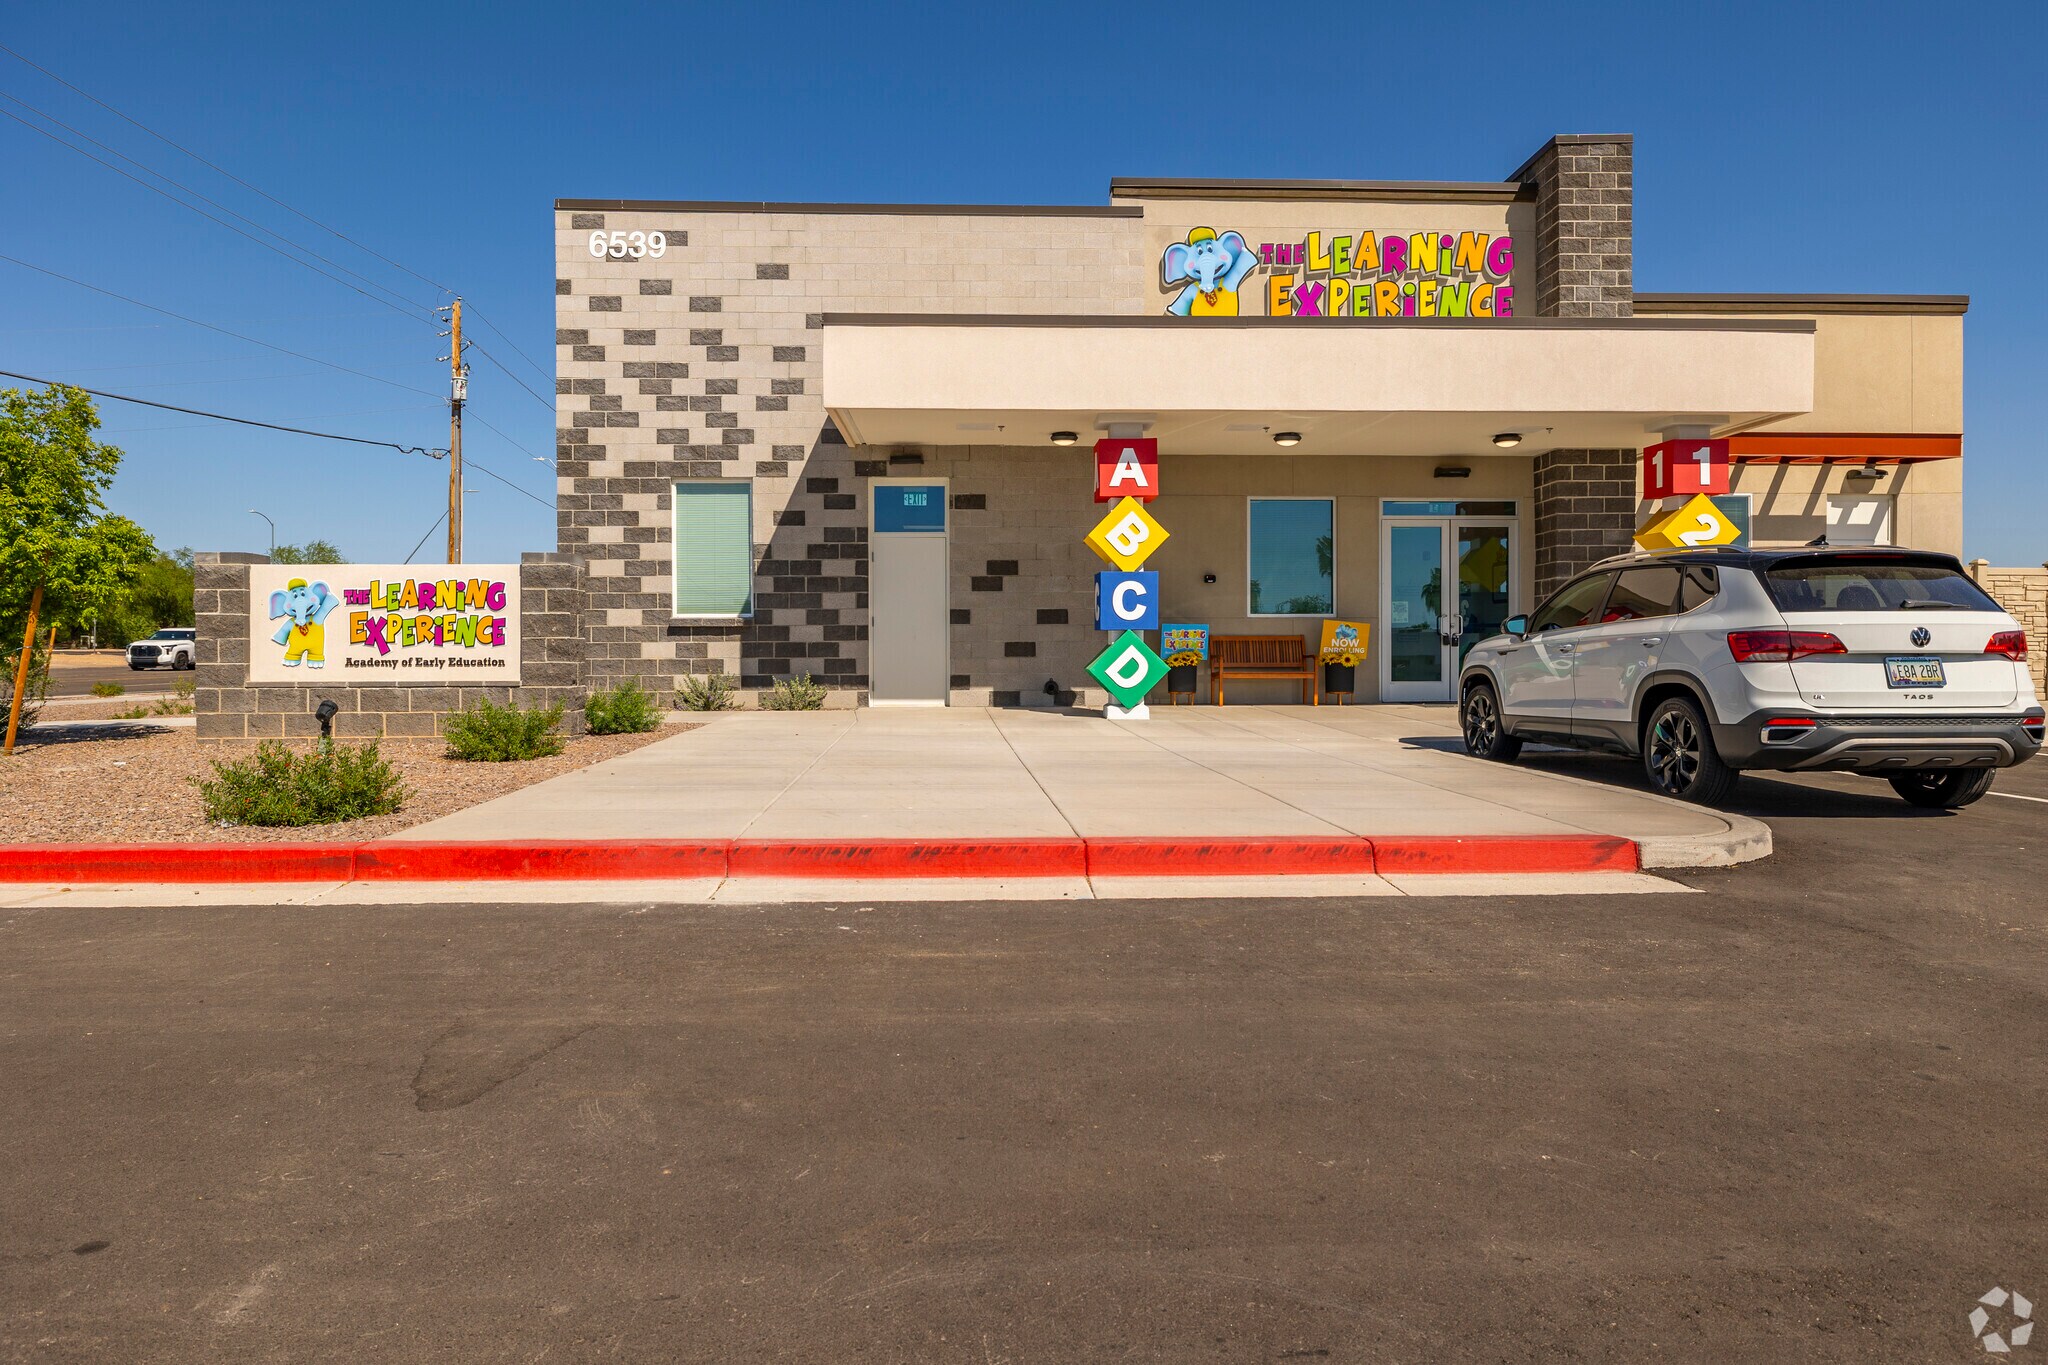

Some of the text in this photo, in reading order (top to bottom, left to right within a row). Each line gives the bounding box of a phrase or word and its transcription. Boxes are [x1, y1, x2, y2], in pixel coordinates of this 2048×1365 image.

[588, 230, 667, 259] 6539
[1260, 243, 1304, 265] THE
[1108, 447, 1149, 488] A
[1692, 446, 1711, 486] 1
[1104, 511, 1150, 556] B
[1678, 513, 1721, 547] 2
[343, 589, 371, 605] THE
[1112, 580, 1147, 621] C
[1331, 638, 1360, 648] NOW
[345, 657, 506, 670] Academy of Early Education
[1104, 644, 1149, 689] D
